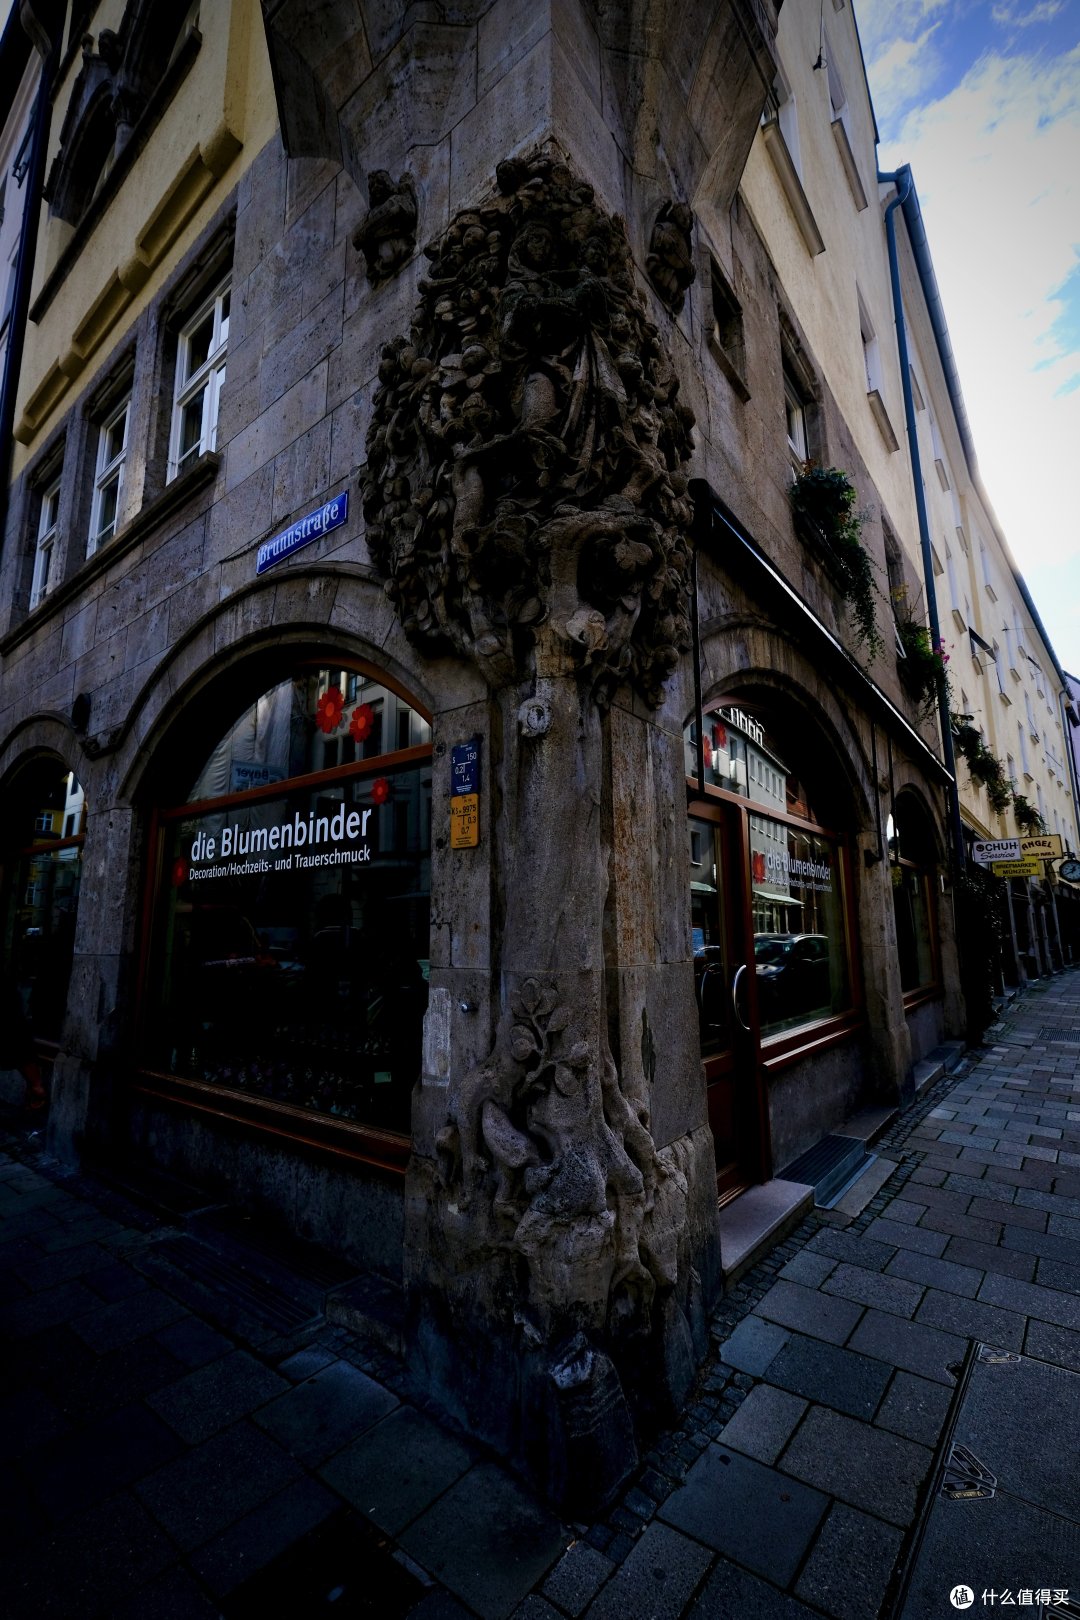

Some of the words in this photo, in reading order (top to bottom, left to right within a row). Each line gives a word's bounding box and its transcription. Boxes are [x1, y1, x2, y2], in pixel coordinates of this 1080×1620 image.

[259, 503, 339, 566] Brunnstraße
[190, 831, 216, 862] die
[221, 802, 372, 857] Blumenbinder
[1021, 840, 1052, 850] ANGEL
[189, 861, 272, 881] Decoration/Hochzeits-
[275, 854, 292, 870] und
[295, 844, 371, 868] Trauerschmuck
